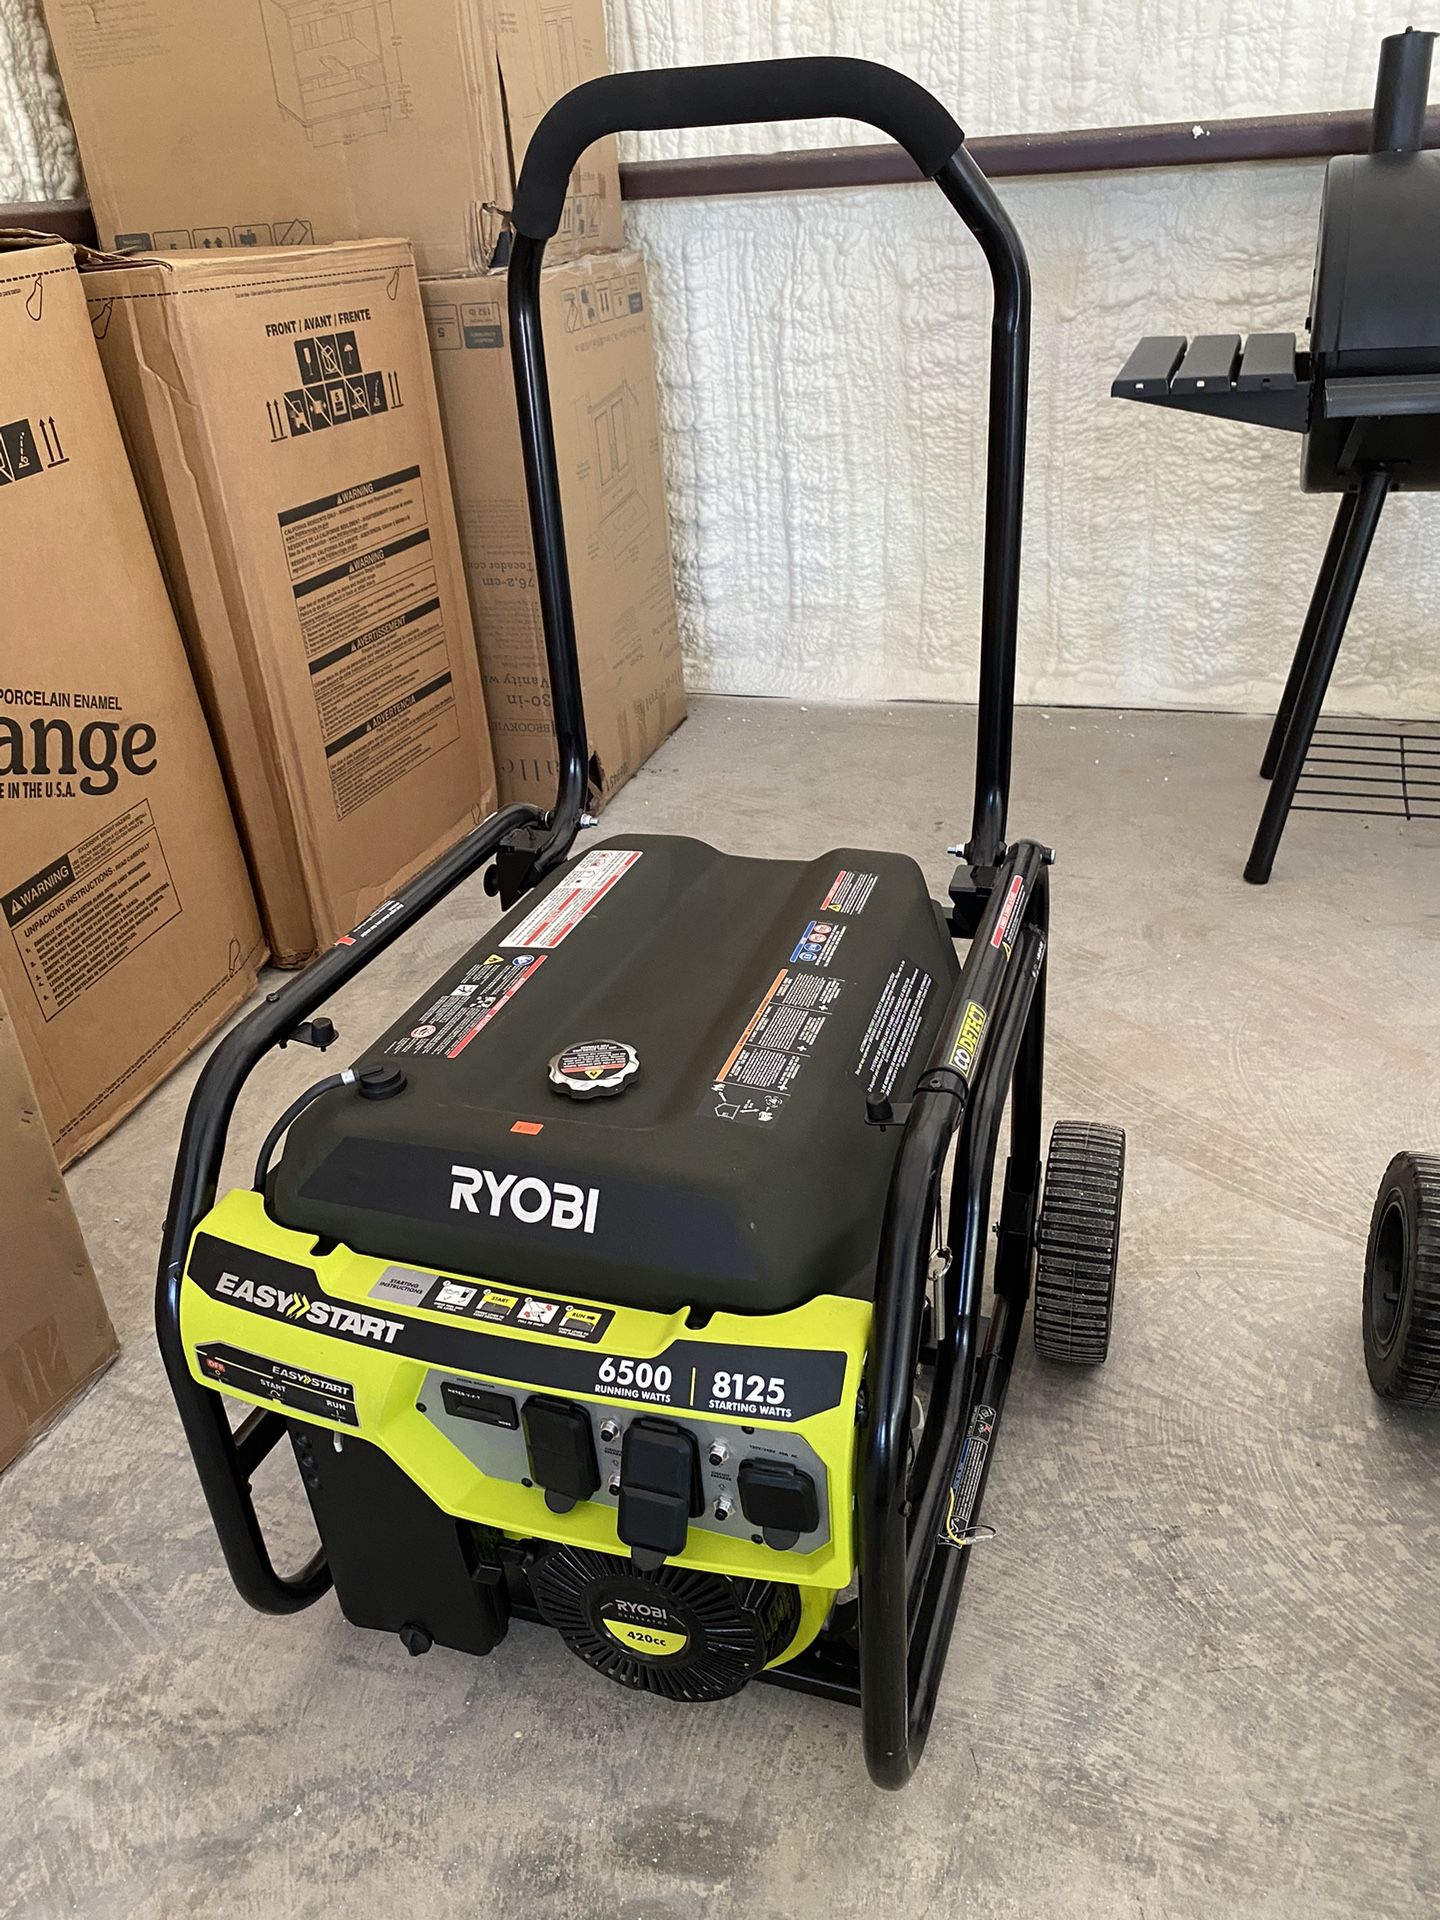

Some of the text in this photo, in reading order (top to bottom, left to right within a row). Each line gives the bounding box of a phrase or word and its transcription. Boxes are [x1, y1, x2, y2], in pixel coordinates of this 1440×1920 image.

[265, 320, 297, 338] FRONT
[304, 313, 332, 331] AVANT
[338, 308, 372, 325] FRENTE
[342, 484, 373, 501] WARNING
[353, 549, 384, 569] WARNING
[357, 616, 405, 647] AVERTISSEMENT
[0, 688, 123, 711] PORCELAIN ENAMEL
[373, 695, 415, 726] ADVERTENCIA
[7, 782, 20, 799] IN
[22, 781, 43, 799] THE
[45, 782, 76, 798] U.S.A.
[20, 866, 68, 904] WARNING
[24, 903, 65, 937] UNPACKING
[65, 868, 112, 906] INSTRUCTIONS
[953, 1005, 985, 1071] CO DETECT
[449, 1164, 600, 1234] RYOBI
[215, 1271, 405, 1344] EASY START
[260, 1379, 287, 1393] START
[272, 1365, 350, 1395] EASY START
[598, 1357, 672, 1391] 6500
[711, 1371, 785, 1404] 8125
[326, 1400, 347, 1411] RUN
[594, 1384, 671, 1403] RUNNING WATTS
[708, 1399, 792, 1418] STARTING WATTS
[615, 1600, 667, 1620] RYOBI
[627, 1631, 667, 1647] 420cc
